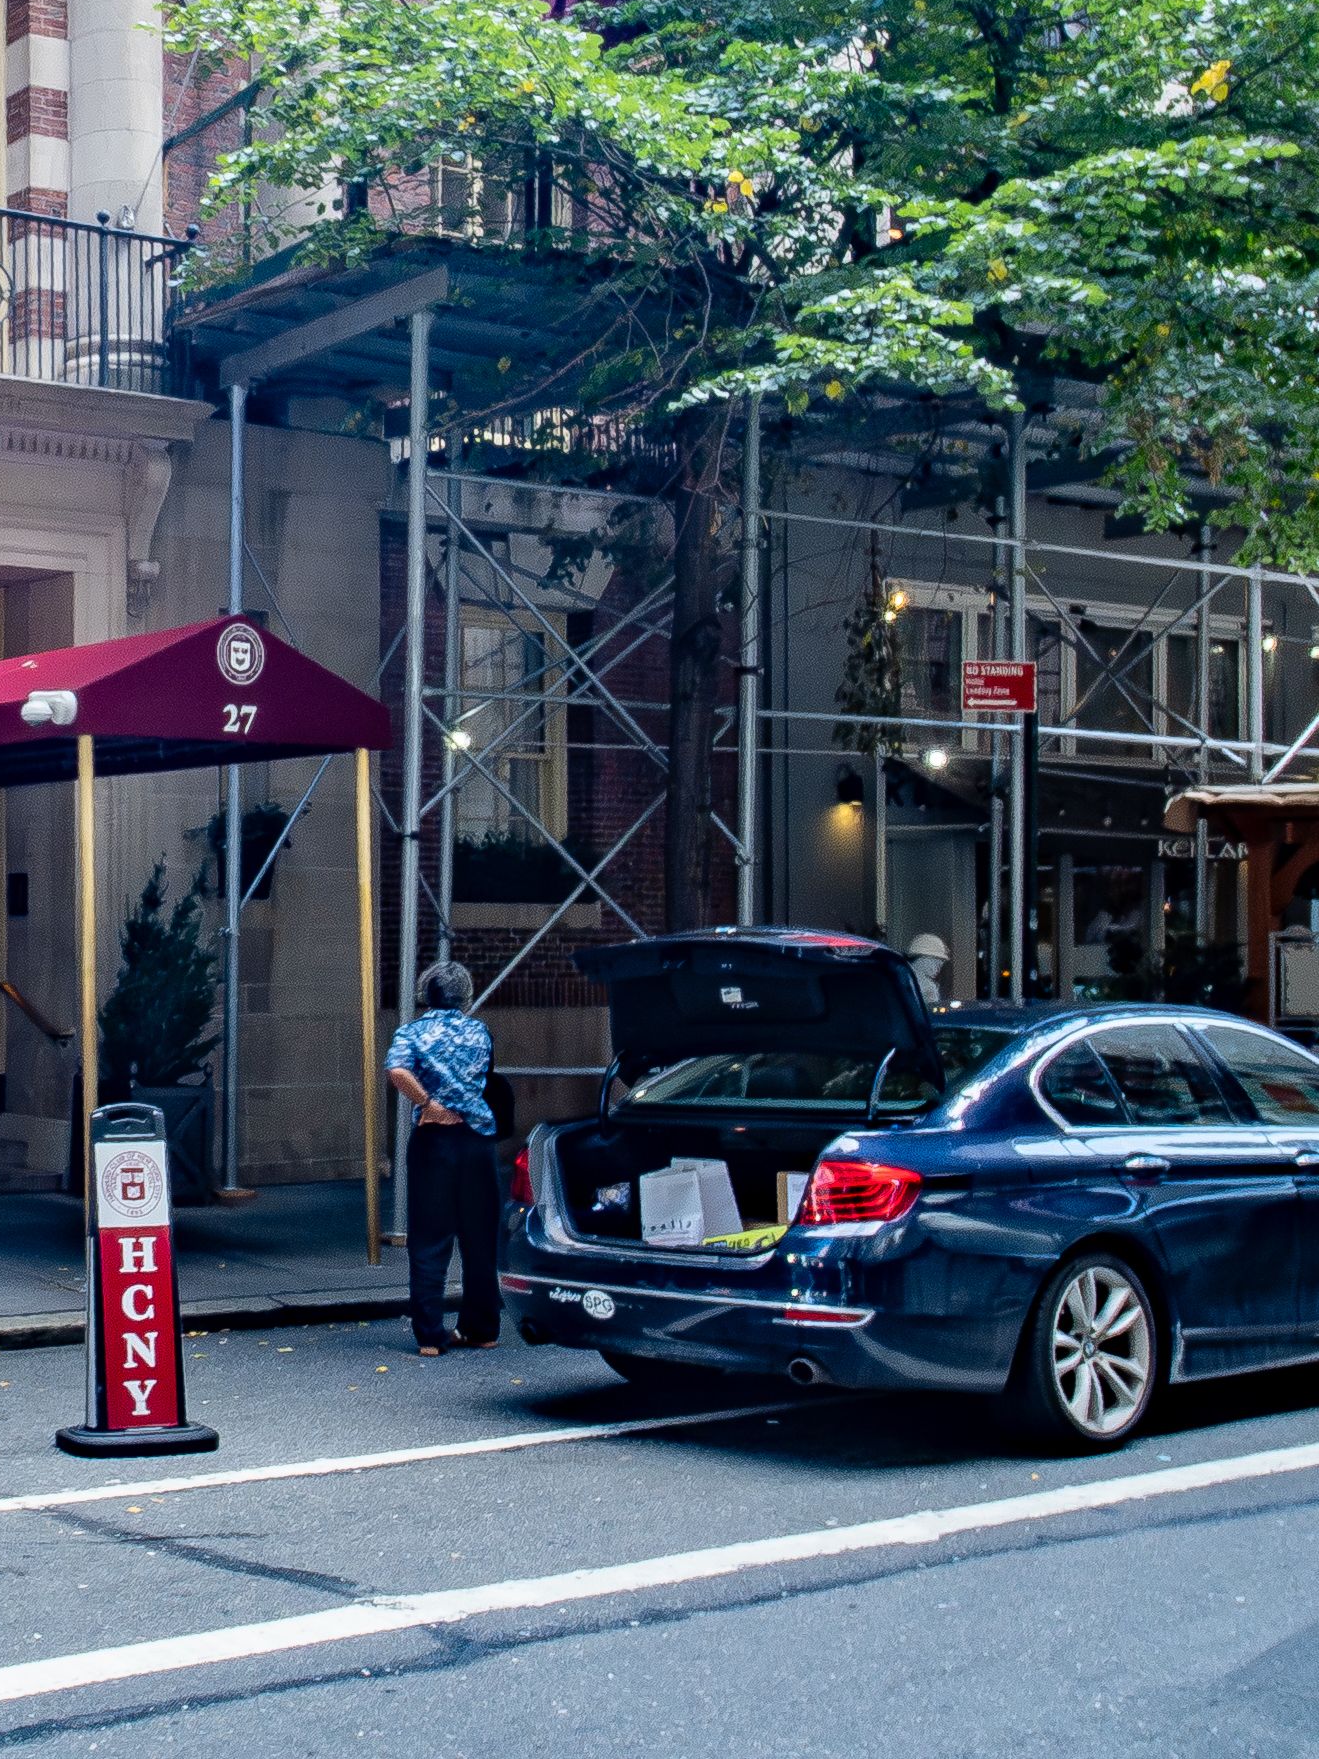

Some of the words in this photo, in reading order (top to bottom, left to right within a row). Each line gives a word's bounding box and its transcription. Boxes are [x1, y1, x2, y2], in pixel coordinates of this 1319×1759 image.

[966, 665, 979, 676] NO
[980, 665, 1024, 677] STANDING
[222, 703, 257, 734] 27
[118, 1236, 158, 1416] HCNY
